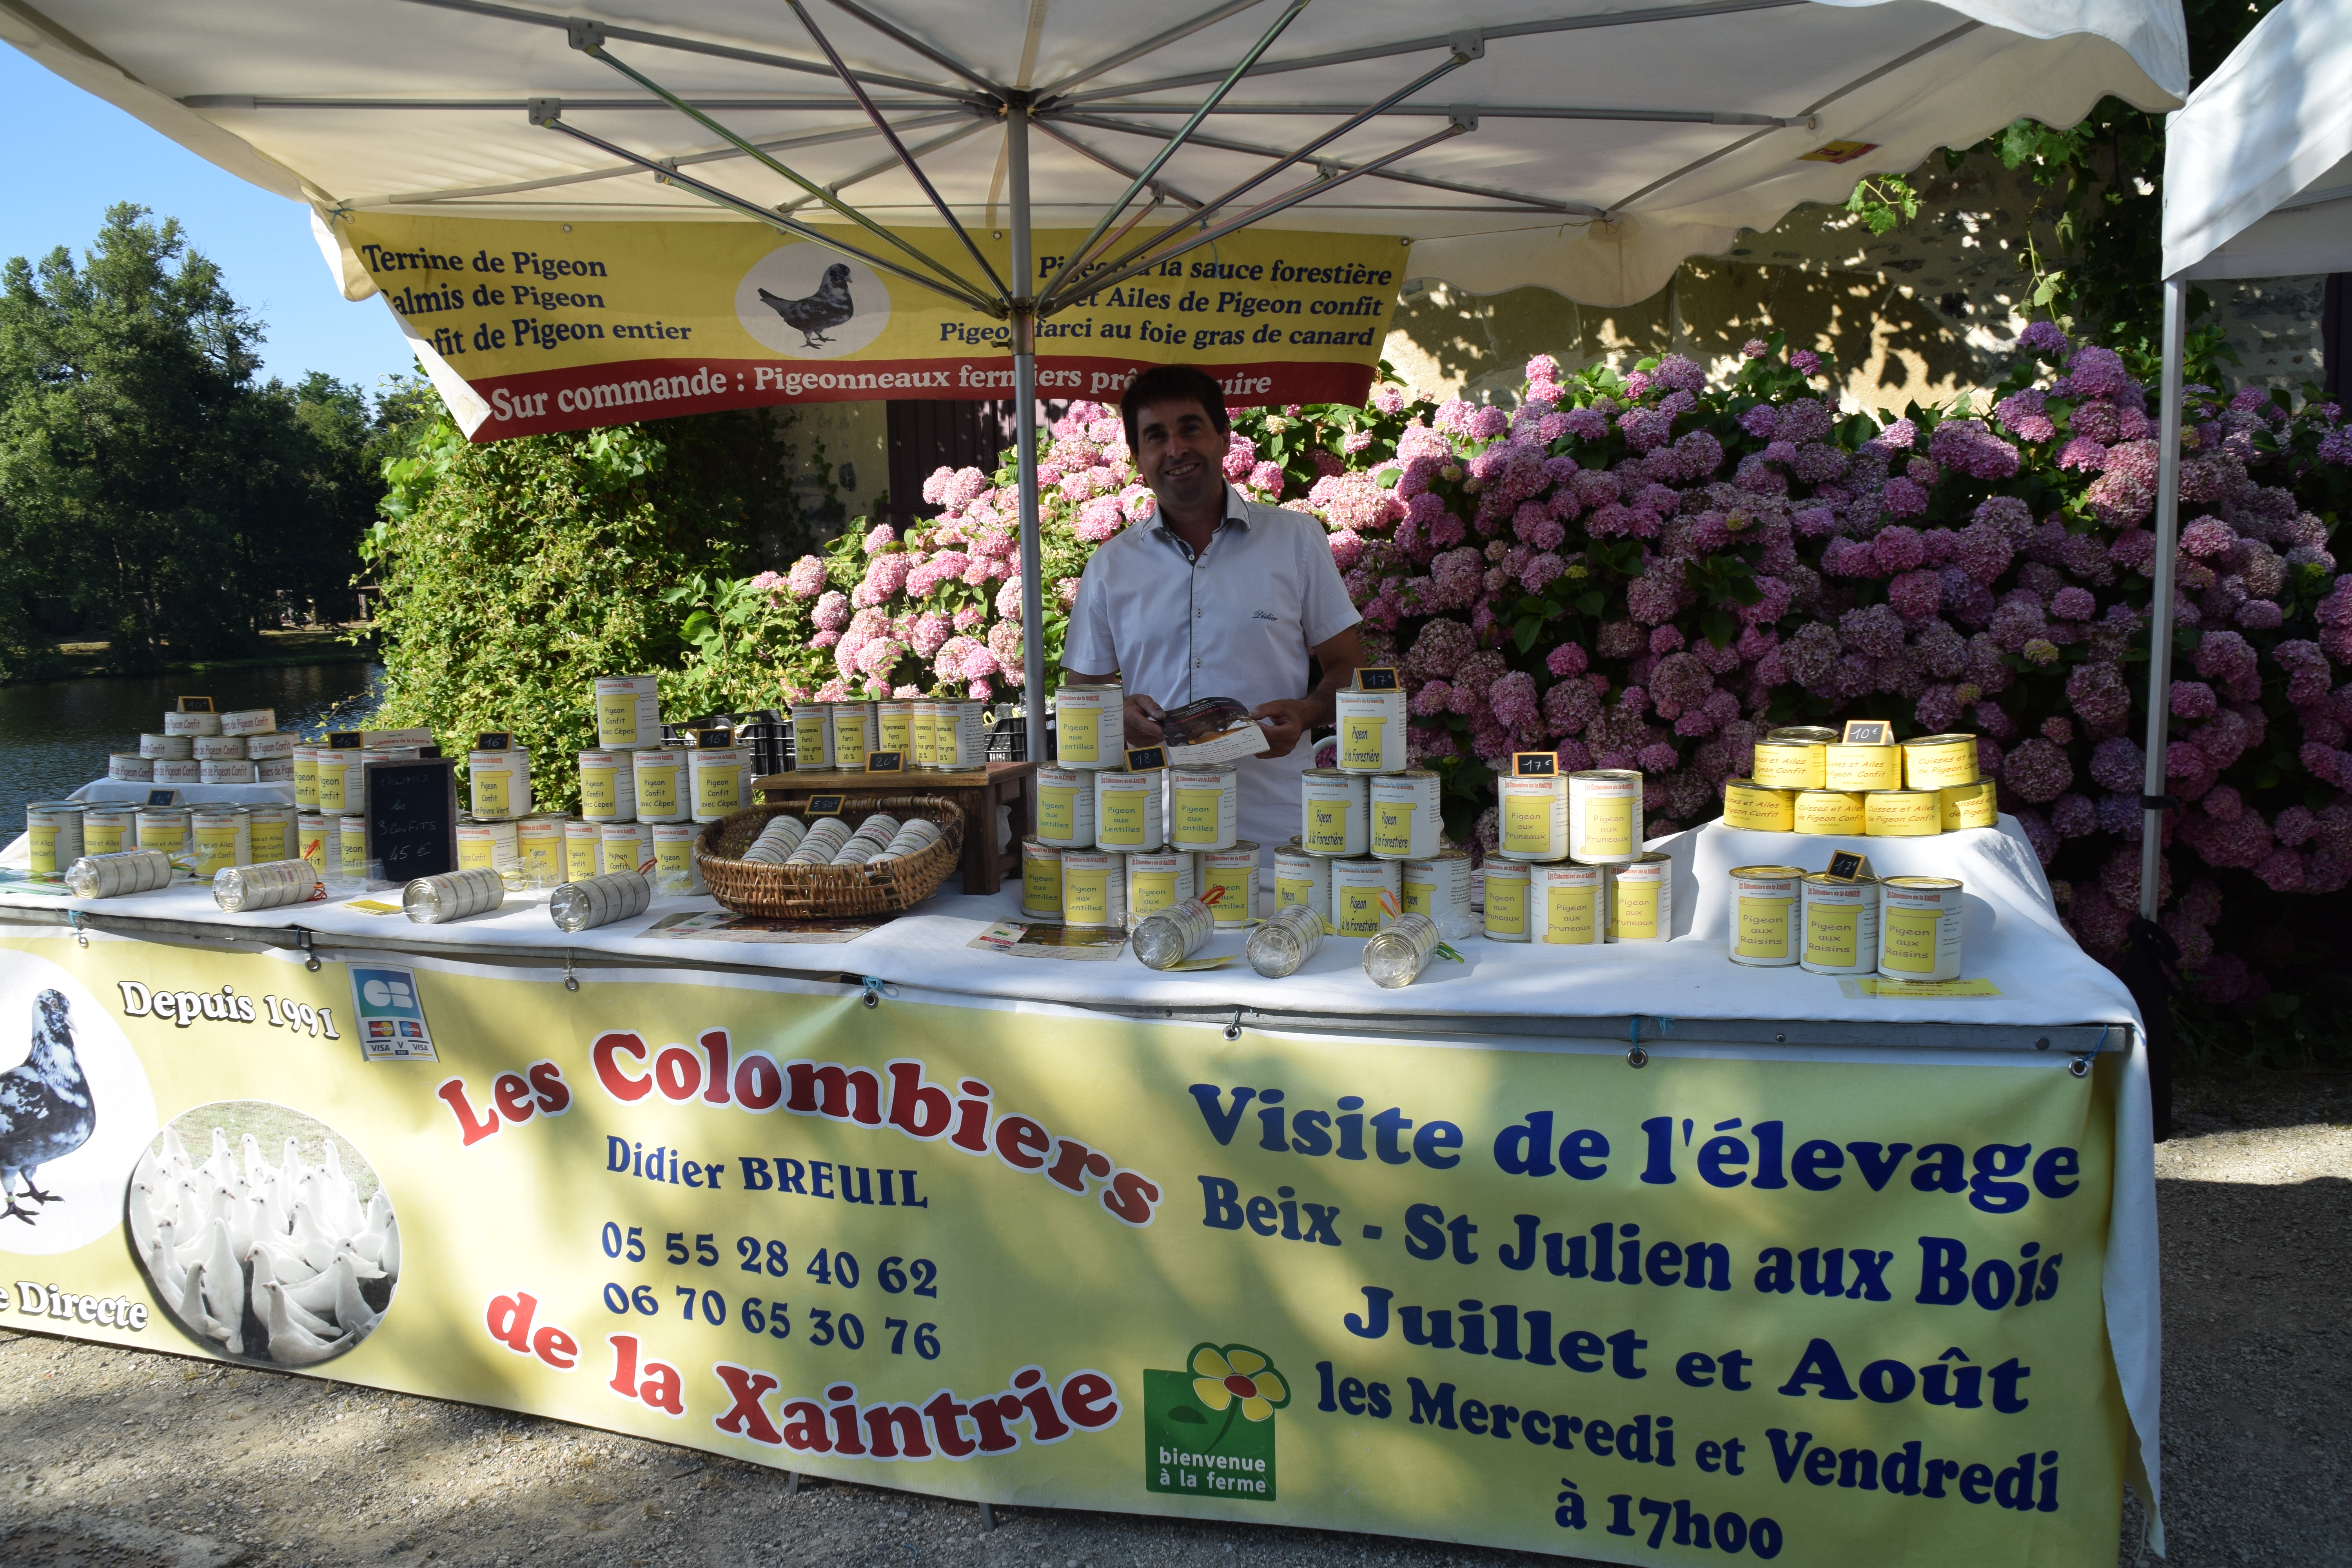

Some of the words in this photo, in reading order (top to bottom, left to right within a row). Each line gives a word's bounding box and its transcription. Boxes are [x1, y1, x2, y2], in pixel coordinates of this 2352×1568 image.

[362, 244, 464, 273] Terrine
[472, 250, 505, 273] de
[511, 252, 608, 280] Pigeon
[1158, 260, 1182, 277] la
[1190, 262, 1263, 281] sauce
[1270, 260, 1392, 285] forestière
[381, 283, 465, 315] almis
[472, 284, 505, 307] de
[511, 285, 606, 310] Pigeon
[1105, 287, 1171, 309] Ailes
[1178, 291, 1209, 312] de
[1216, 291, 1302, 318] Pigeon
[1310, 296, 1383, 316] confit
[474, 323, 506, 351] de
[512, 318, 606, 350] Pigeon
[612, 321, 692, 341] entier
[939, 323, 1010, 345] Pigeo
[1034, 318, 1093, 338] farci
[1100, 323, 1132, 339] au
[1139, 320, 1187, 344] foie
[1192, 329, 1245, 350] gras
[1252, 323, 1282, 343] de
[1289, 327, 1375, 346] canard
[491, 388, 549, 421] Sur
[557, 367, 728, 412] commande
[753, 367, 950, 396] Pigeonneaux
[1252, 610, 1278, 621] Didier
[1063, 724, 1089, 732] Pigeon
[1352, 726, 1368, 743] Pigeon
[1348, 748, 1352, 761] la
[1352, 748, 1379, 762] Forestière
[214, 765, 230, 779] Pigeon
[232, 765, 247, 777] Confit
[295, 771, 316, 783] Pigeon
[706, 779, 729, 787] Pigeon
[296, 787, 316, 796] Confit
[481, 782, 497, 793] Pigeon
[718, 800, 738, 809] Cèpes
[1108, 806, 1135, 815] Pigeon
[878, 831, 891, 842] PIGEON
[1557, 904, 1587, 913] Pigeon
[1743, 915, 1782, 924] Pigeon
[1740, 936, 1782, 944] Raisins
[118, 980, 256, 1026] Depuis
[267, 995, 340, 1040] 1991
[437, 1060, 571, 1147] Les
[592, 1030, 1160, 1225] Colombiers
[1188, 1083, 1464, 1169] Visite
[1493, 1110, 1610, 1181] de
[1639, 1116, 2080, 1214] l'élevage
[606, 1134, 725, 1189] Didier
[738, 1156, 928, 1209] BREUIL
[1197, 1174, 1342, 1247] Beix
[1404, 1202, 1479, 1265] St
[1498, 1213, 1731, 1292] Julien
[1754, 1246, 1894, 1302] aux
[1915, 1235, 2063, 1311] Bois
[601, 1221, 646, 1263] 05
[665, 1232, 720, 1267] 55
[736, 1236, 789, 1278] 28
[806, 1247, 860, 1289] 40
[877, 1256, 938, 1299] 62
[14, 1280, 149, 1332] Directe
[603, 1282, 659, 1316] 06
[675, 1285, 727, 1326] 70
[741, 1297, 791, 1339] 65
[809, 1307, 865, 1350] 30
[884, 1316, 941, 1361] 76
[1343, 1285, 1648, 1379] Juillet
[1675, 1348, 1753, 1391] et
[1777, 1337, 2031, 1414] Août
[486, 1291, 579, 1370] de
[608, 1334, 684, 1416] la
[714, 1365, 1120, 1457] Xaintrie
[1314, 1360, 1392, 1419] les
[1406, 1376, 1676, 1467] Mercredi
[1695, 1437, 1746, 1476] et
[1764, 1428, 2059, 1512] Vendredi
[1159, 1446, 1266, 1472] bienvenue
[1159, 1468, 1171, 1486] à
[1180, 1469, 1197, 1488] la
[1206, 1471, 1267, 1493] ferme
[1554, 1477, 1588, 1530] à
[1606, 1494, 1783, 1560] 17h00
